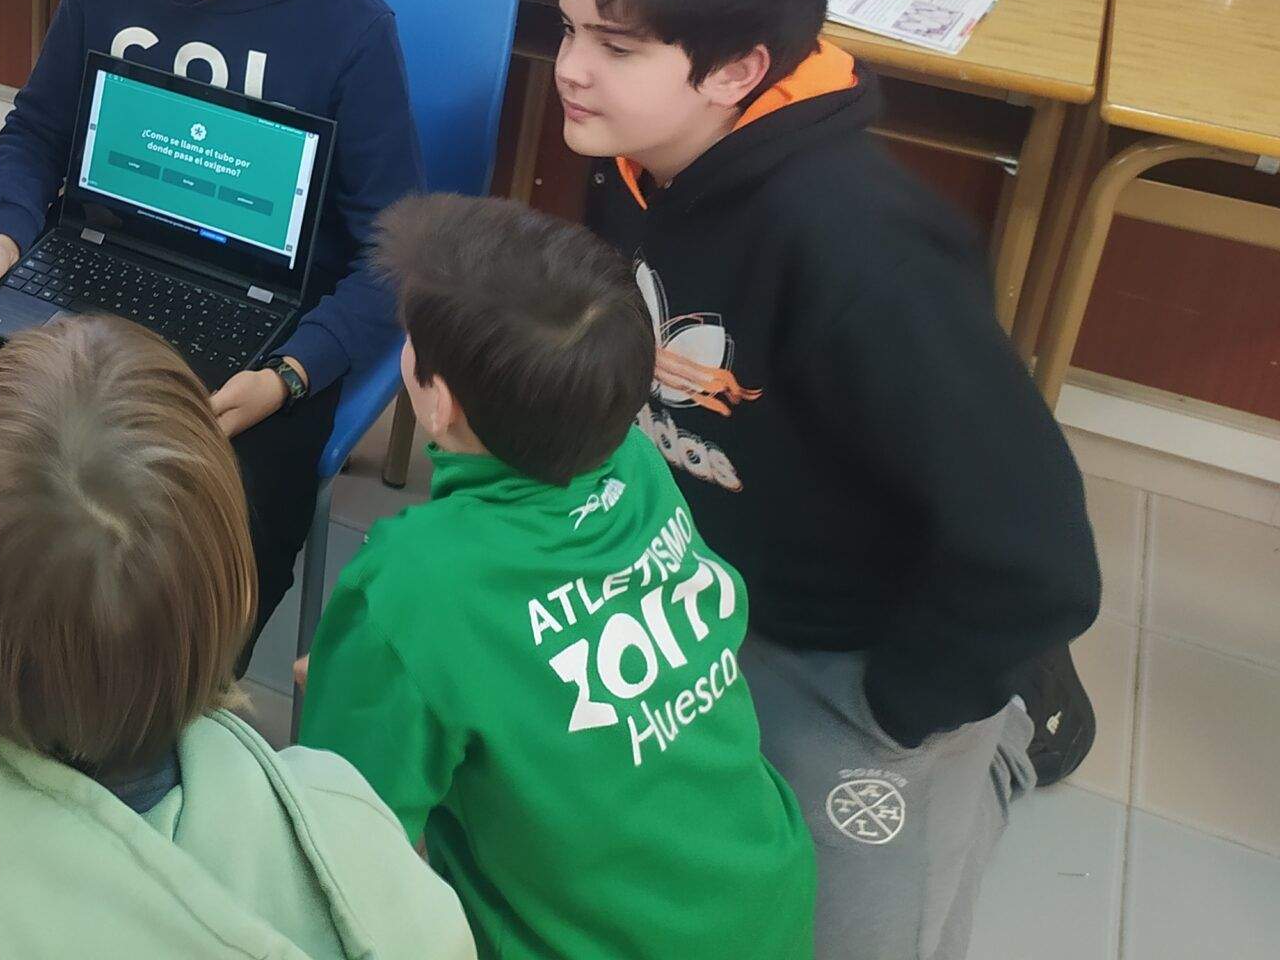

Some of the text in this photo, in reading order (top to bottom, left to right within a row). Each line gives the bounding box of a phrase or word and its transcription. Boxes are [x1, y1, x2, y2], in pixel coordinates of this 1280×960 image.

[147, 141, 172, 157] donde
[174, 150, 194, 163] pasa
[194, 155, 203, 165] el
[170, 136, 180, 146] se
[180, 139, 204, 155] llama
[205, 147, 214, 158] el
[214, 149, 235, 164] tubo
[236, 157, 251, 169] por
[528, 506, 692, 646] ATLETISMO
